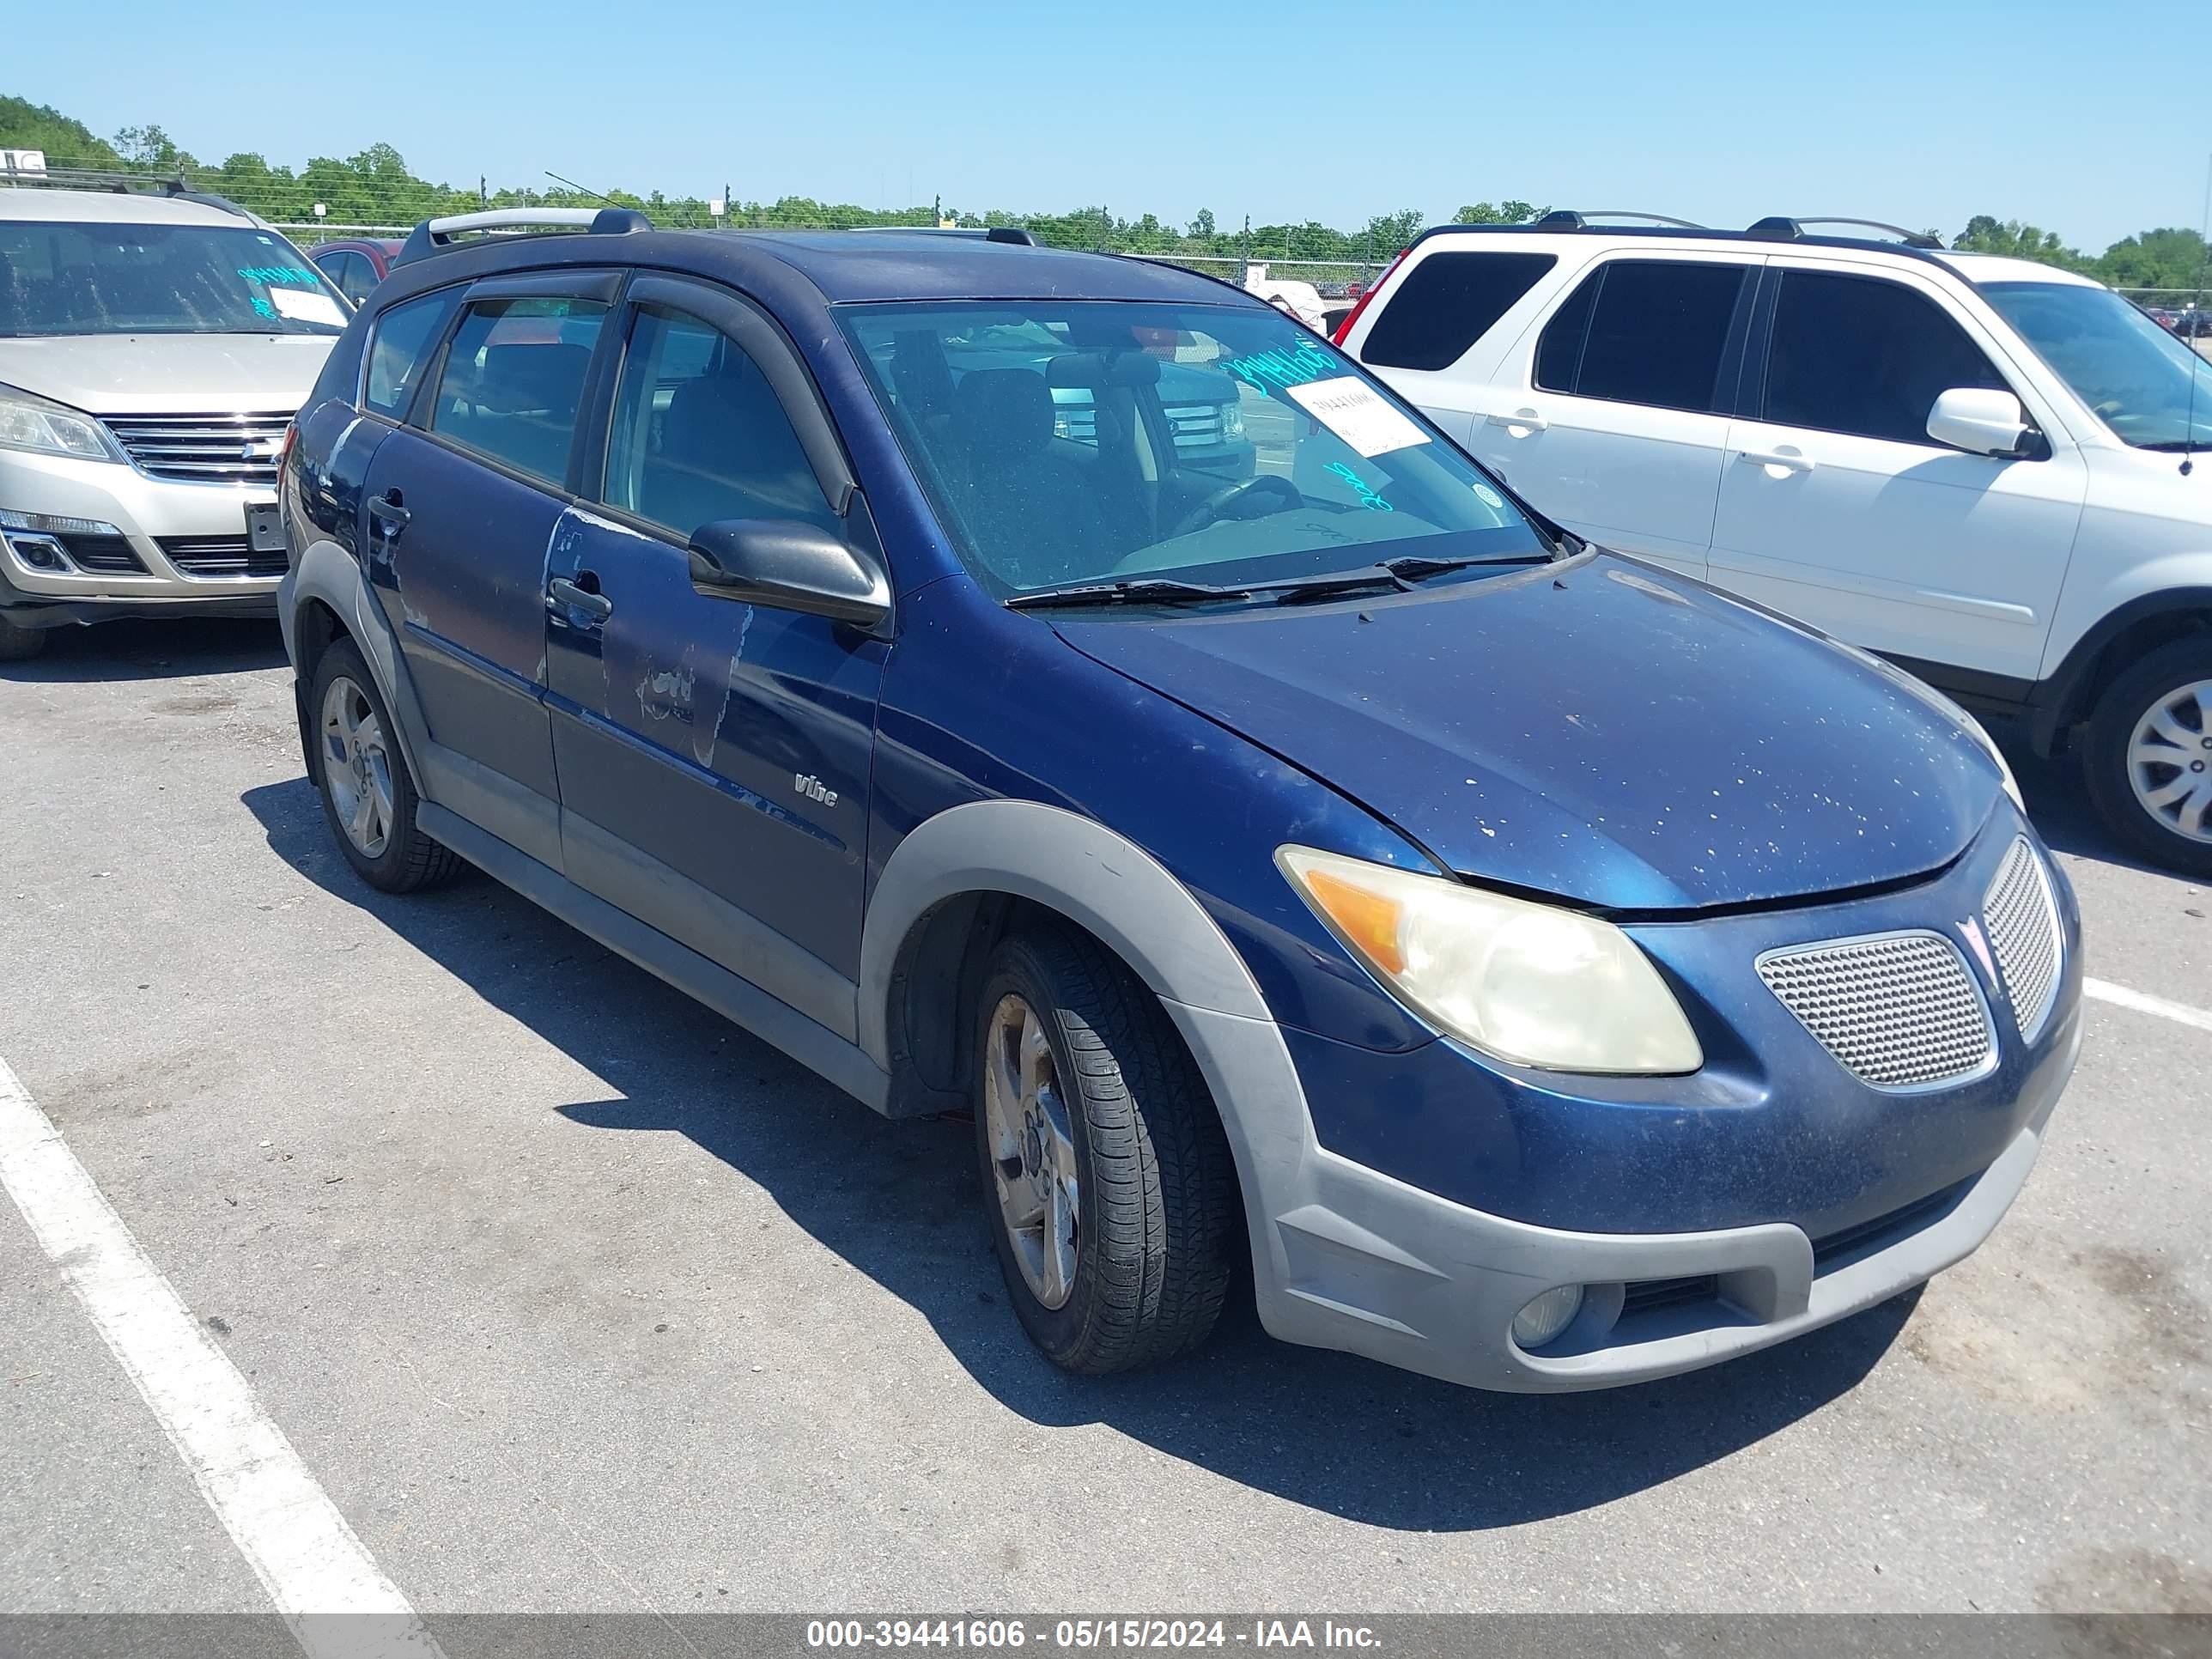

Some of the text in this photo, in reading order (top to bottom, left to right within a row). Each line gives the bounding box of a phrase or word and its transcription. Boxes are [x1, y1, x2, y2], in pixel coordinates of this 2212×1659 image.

[1219, 340, 1337, 398] 39441606
[1322, 461, 1393, 512] 2006
[794, 773, 839, 808] vibe
